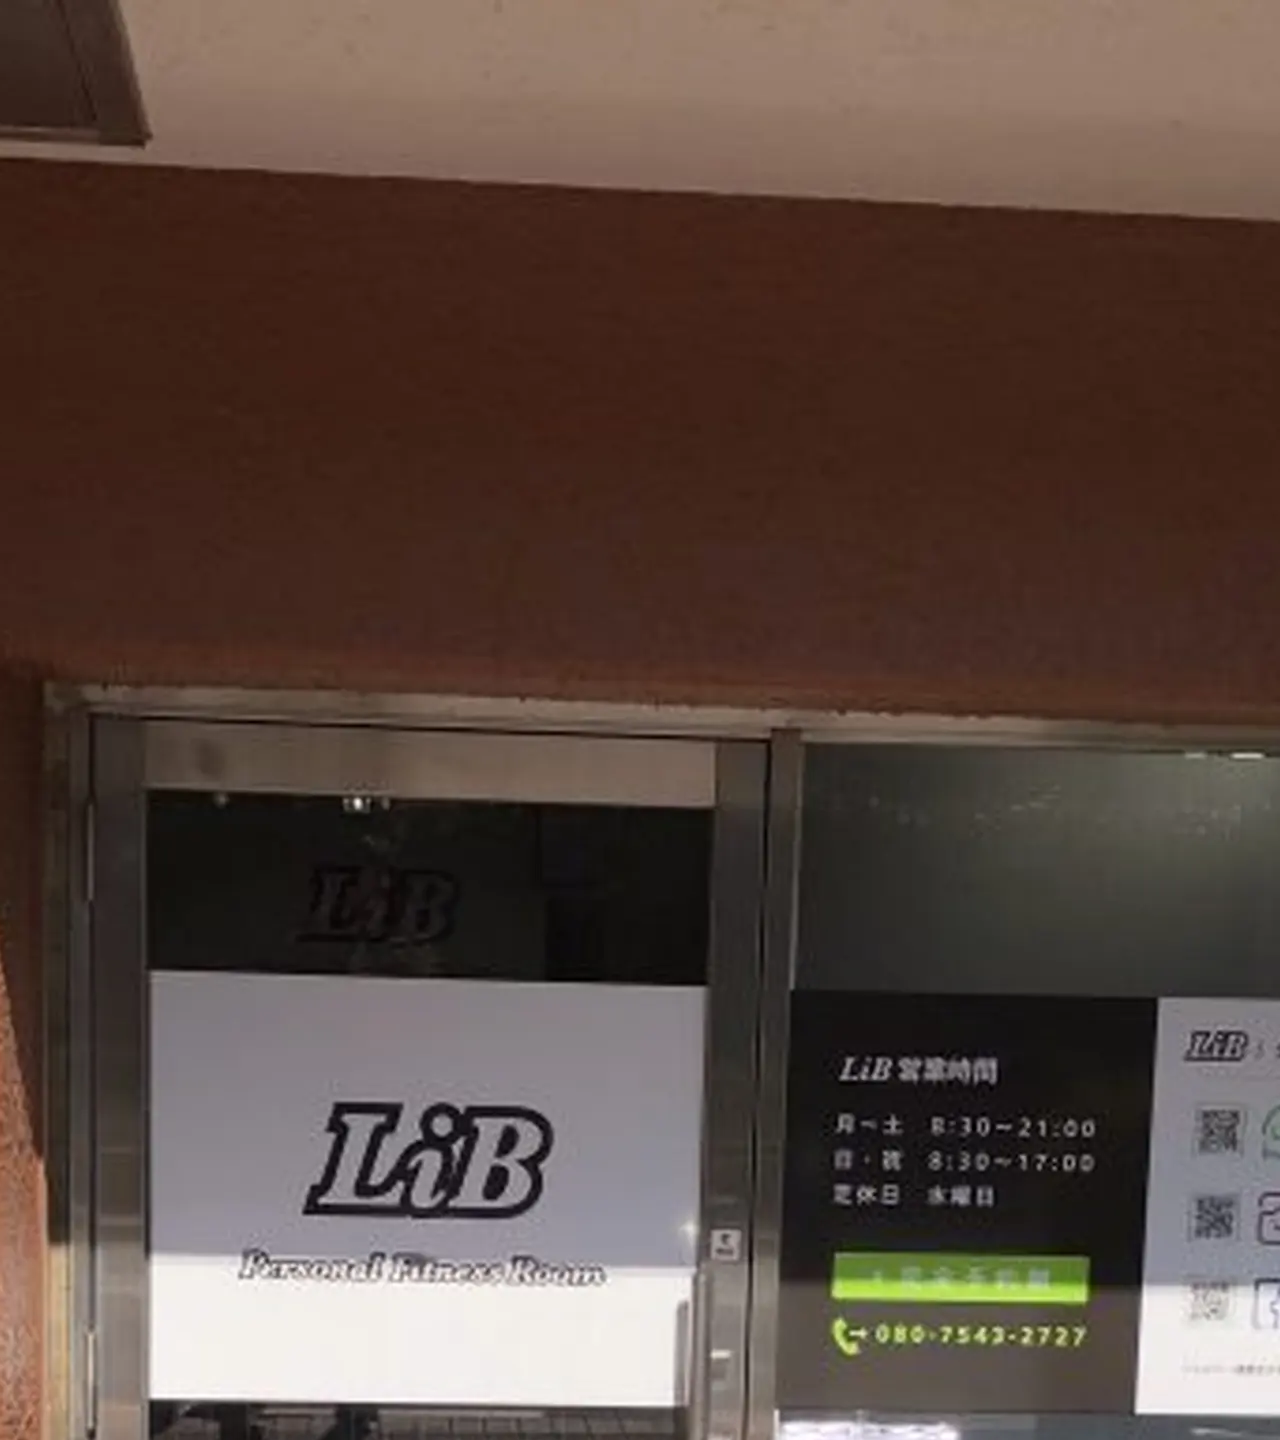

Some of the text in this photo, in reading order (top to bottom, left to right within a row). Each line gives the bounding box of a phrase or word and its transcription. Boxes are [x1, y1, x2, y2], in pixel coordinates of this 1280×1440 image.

[838, 1056, 893, 1082] LiB
[303, 1101, 554, 1219] LiB
[238, 1248, 606, 1286] Personal Fitness Room
